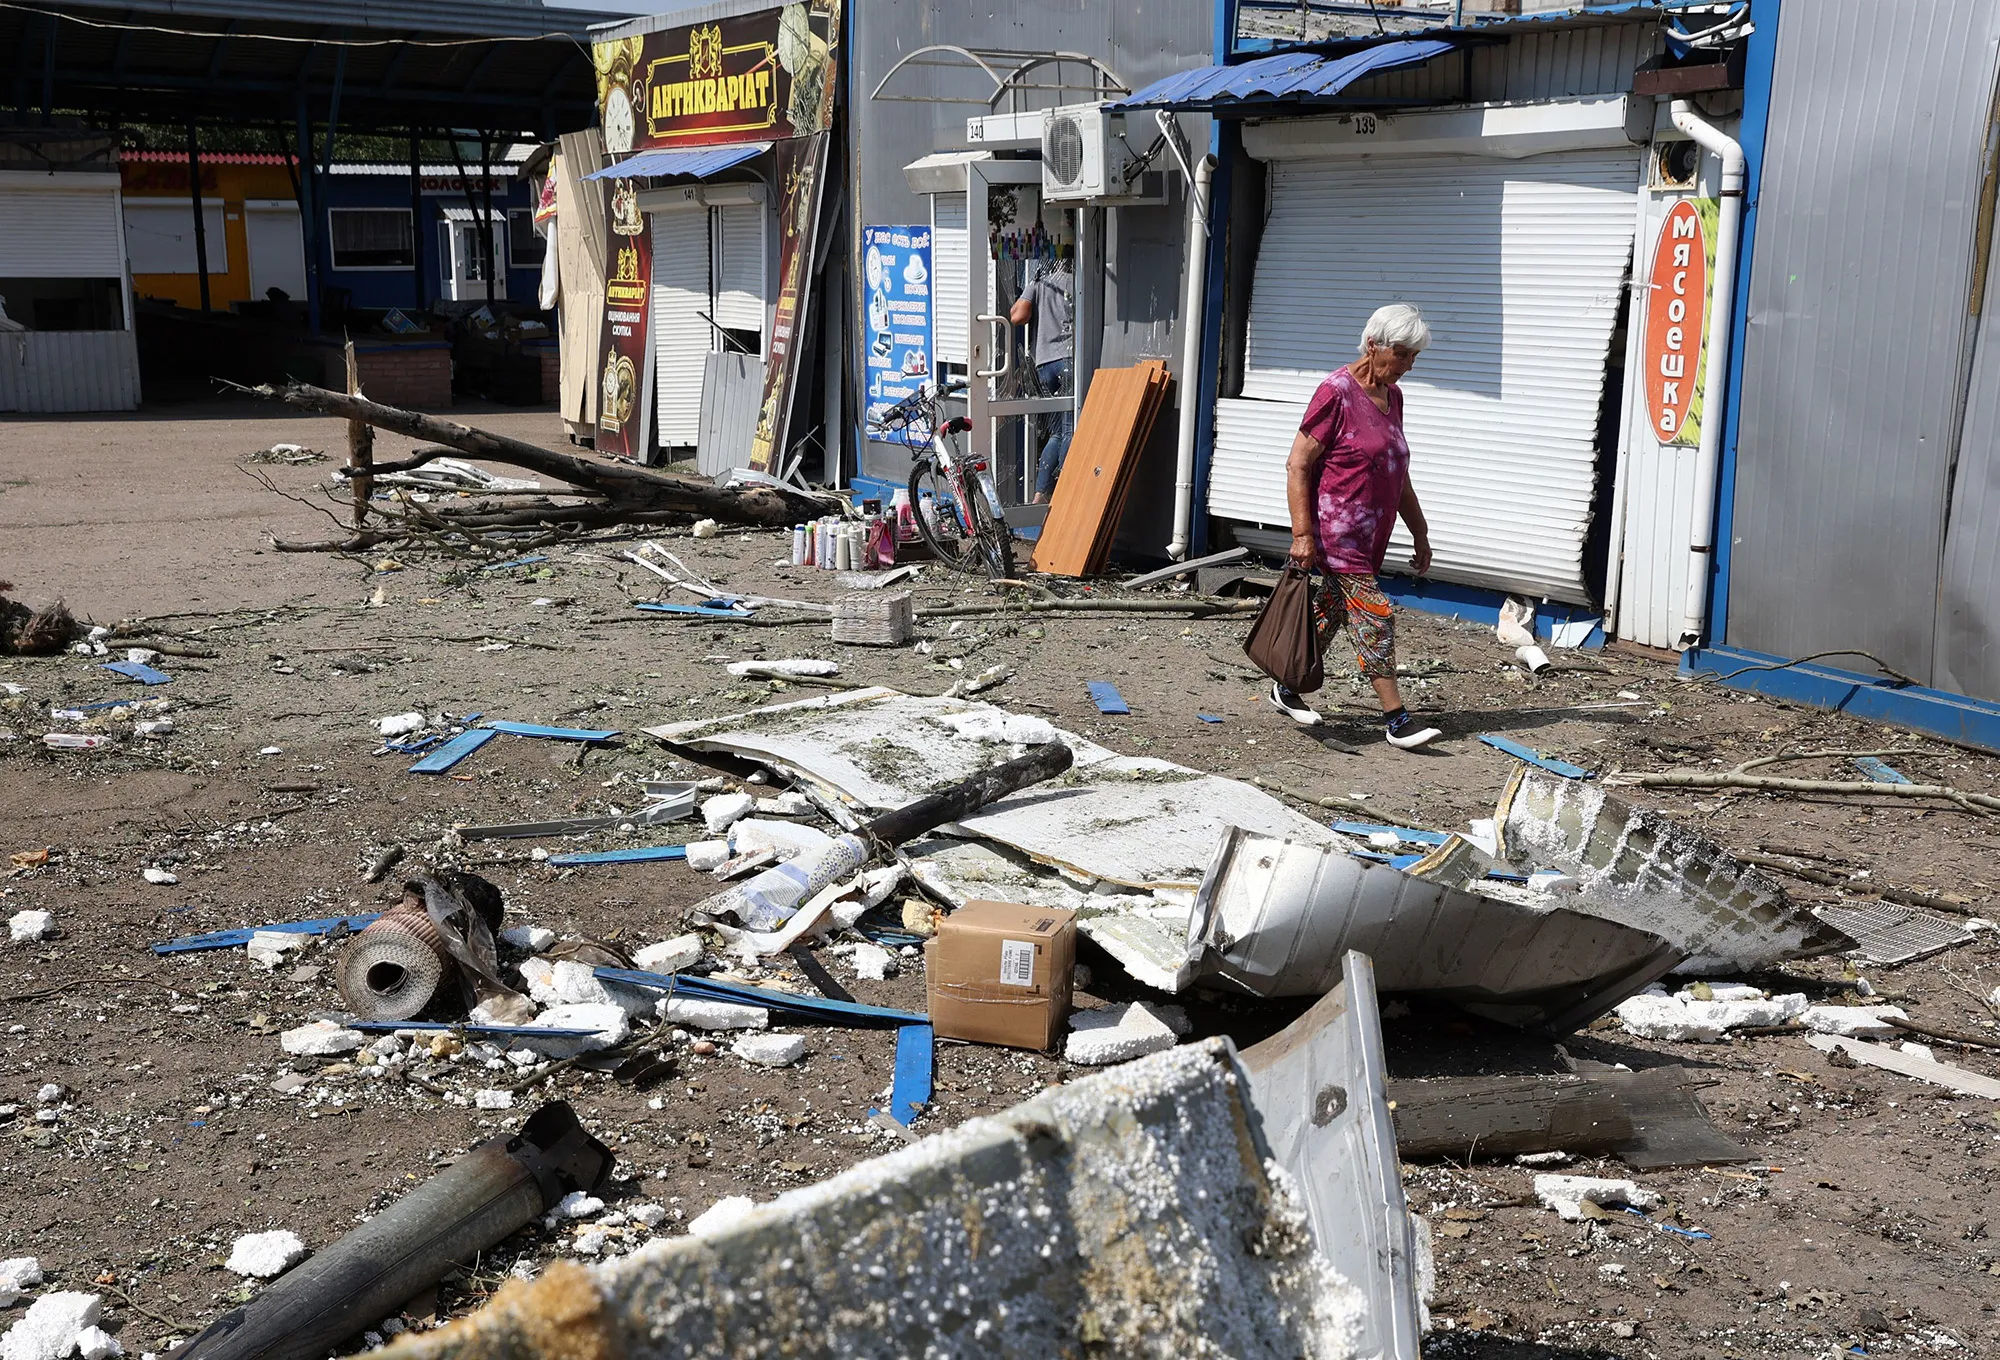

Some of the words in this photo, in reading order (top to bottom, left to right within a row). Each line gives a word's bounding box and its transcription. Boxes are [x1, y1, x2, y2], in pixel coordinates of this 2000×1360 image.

[652, 70, 769, 119] АНТИКВАРІАТ
[970, 125, 984, 138] 140
[1355, 117, 1376, 134] 139
[684, 189, 695, 200] 141
